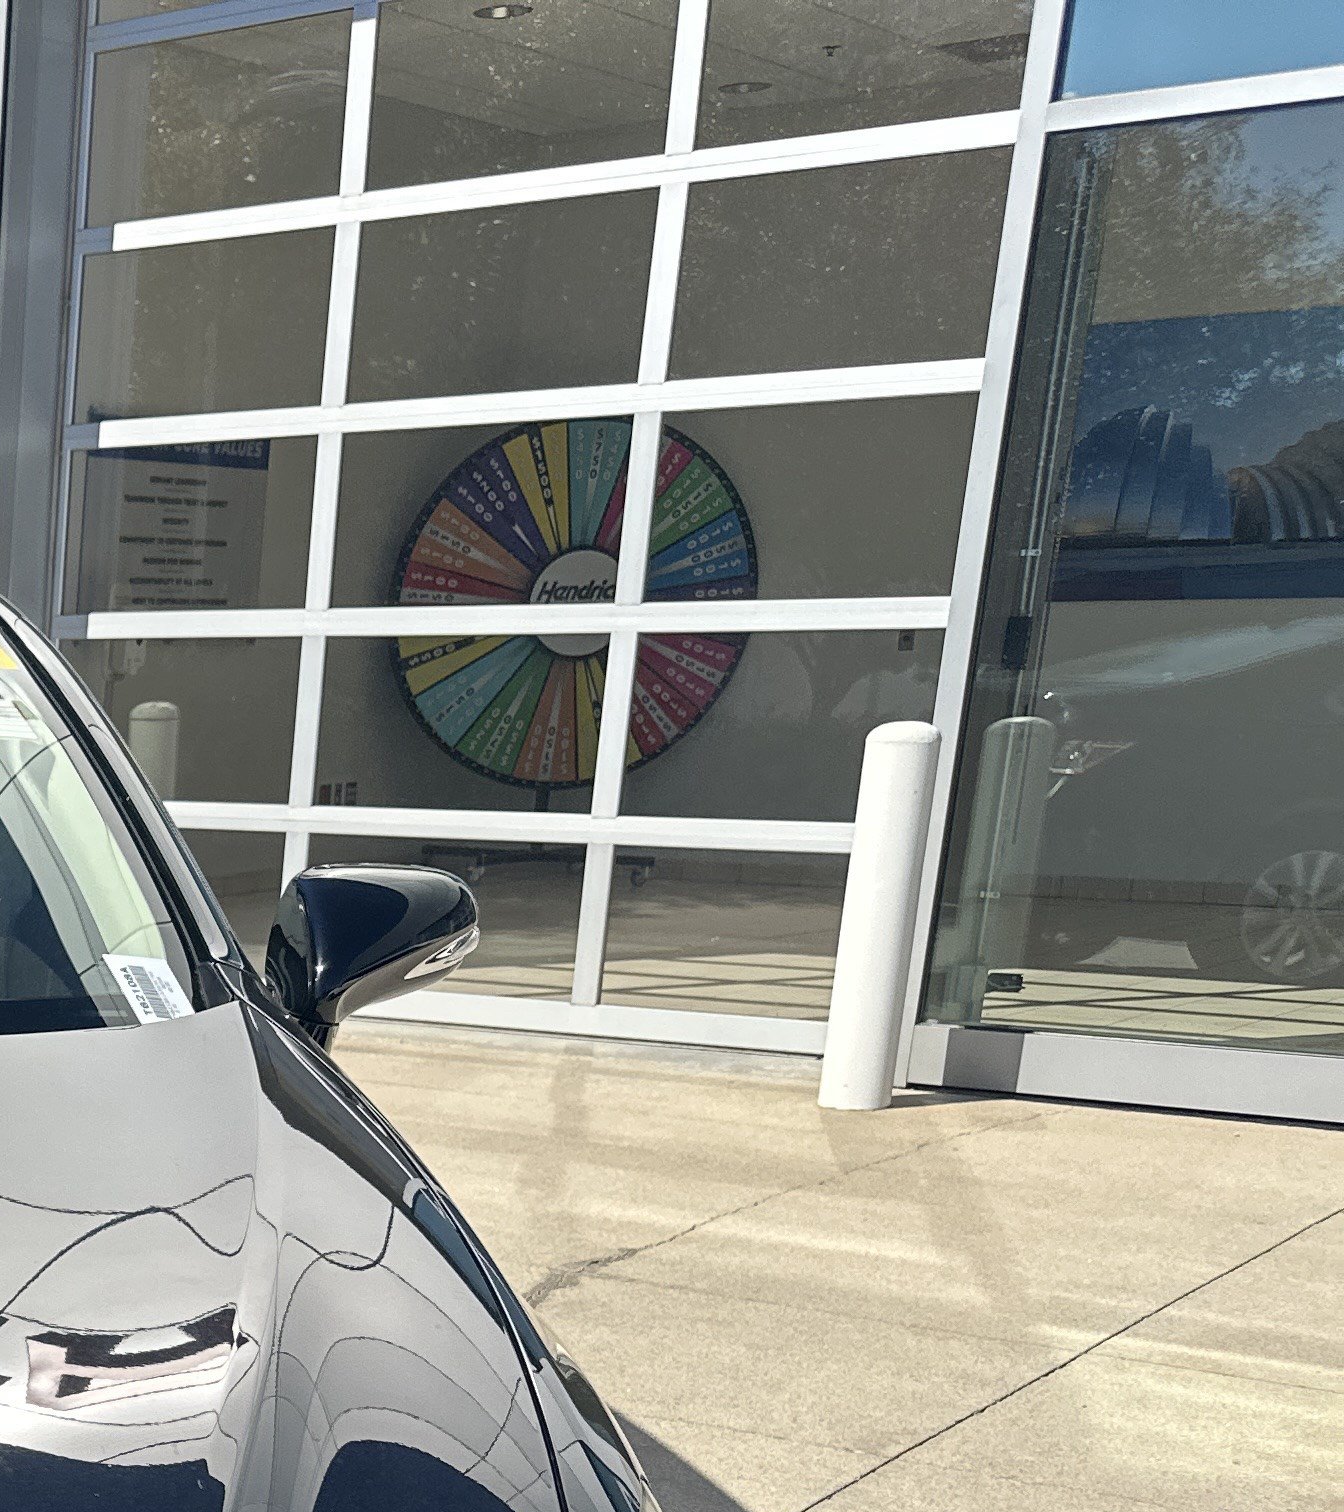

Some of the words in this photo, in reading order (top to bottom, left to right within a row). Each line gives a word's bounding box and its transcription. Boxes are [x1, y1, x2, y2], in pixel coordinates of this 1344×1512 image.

[531, 436, 552, 499] $1500
[589, 428, 604, 479] $750
[473, 471, 504, 511] $200
[490, 458, 517, 502] $100
[664, 468, 701, 509] $100
[457, 486, 493, 522] $100
[672, 482, 713, 519] $150
[679, 497, 721, 531] $100
[687, 521, 733, 549] $100
[693, 558, 742, 577] $100
[537, 579, 616, 603] Hendric
[695, 587, 744, 598] $100
[436, 687, 475, 723] $150
[653, 683, 687, 718] $100
